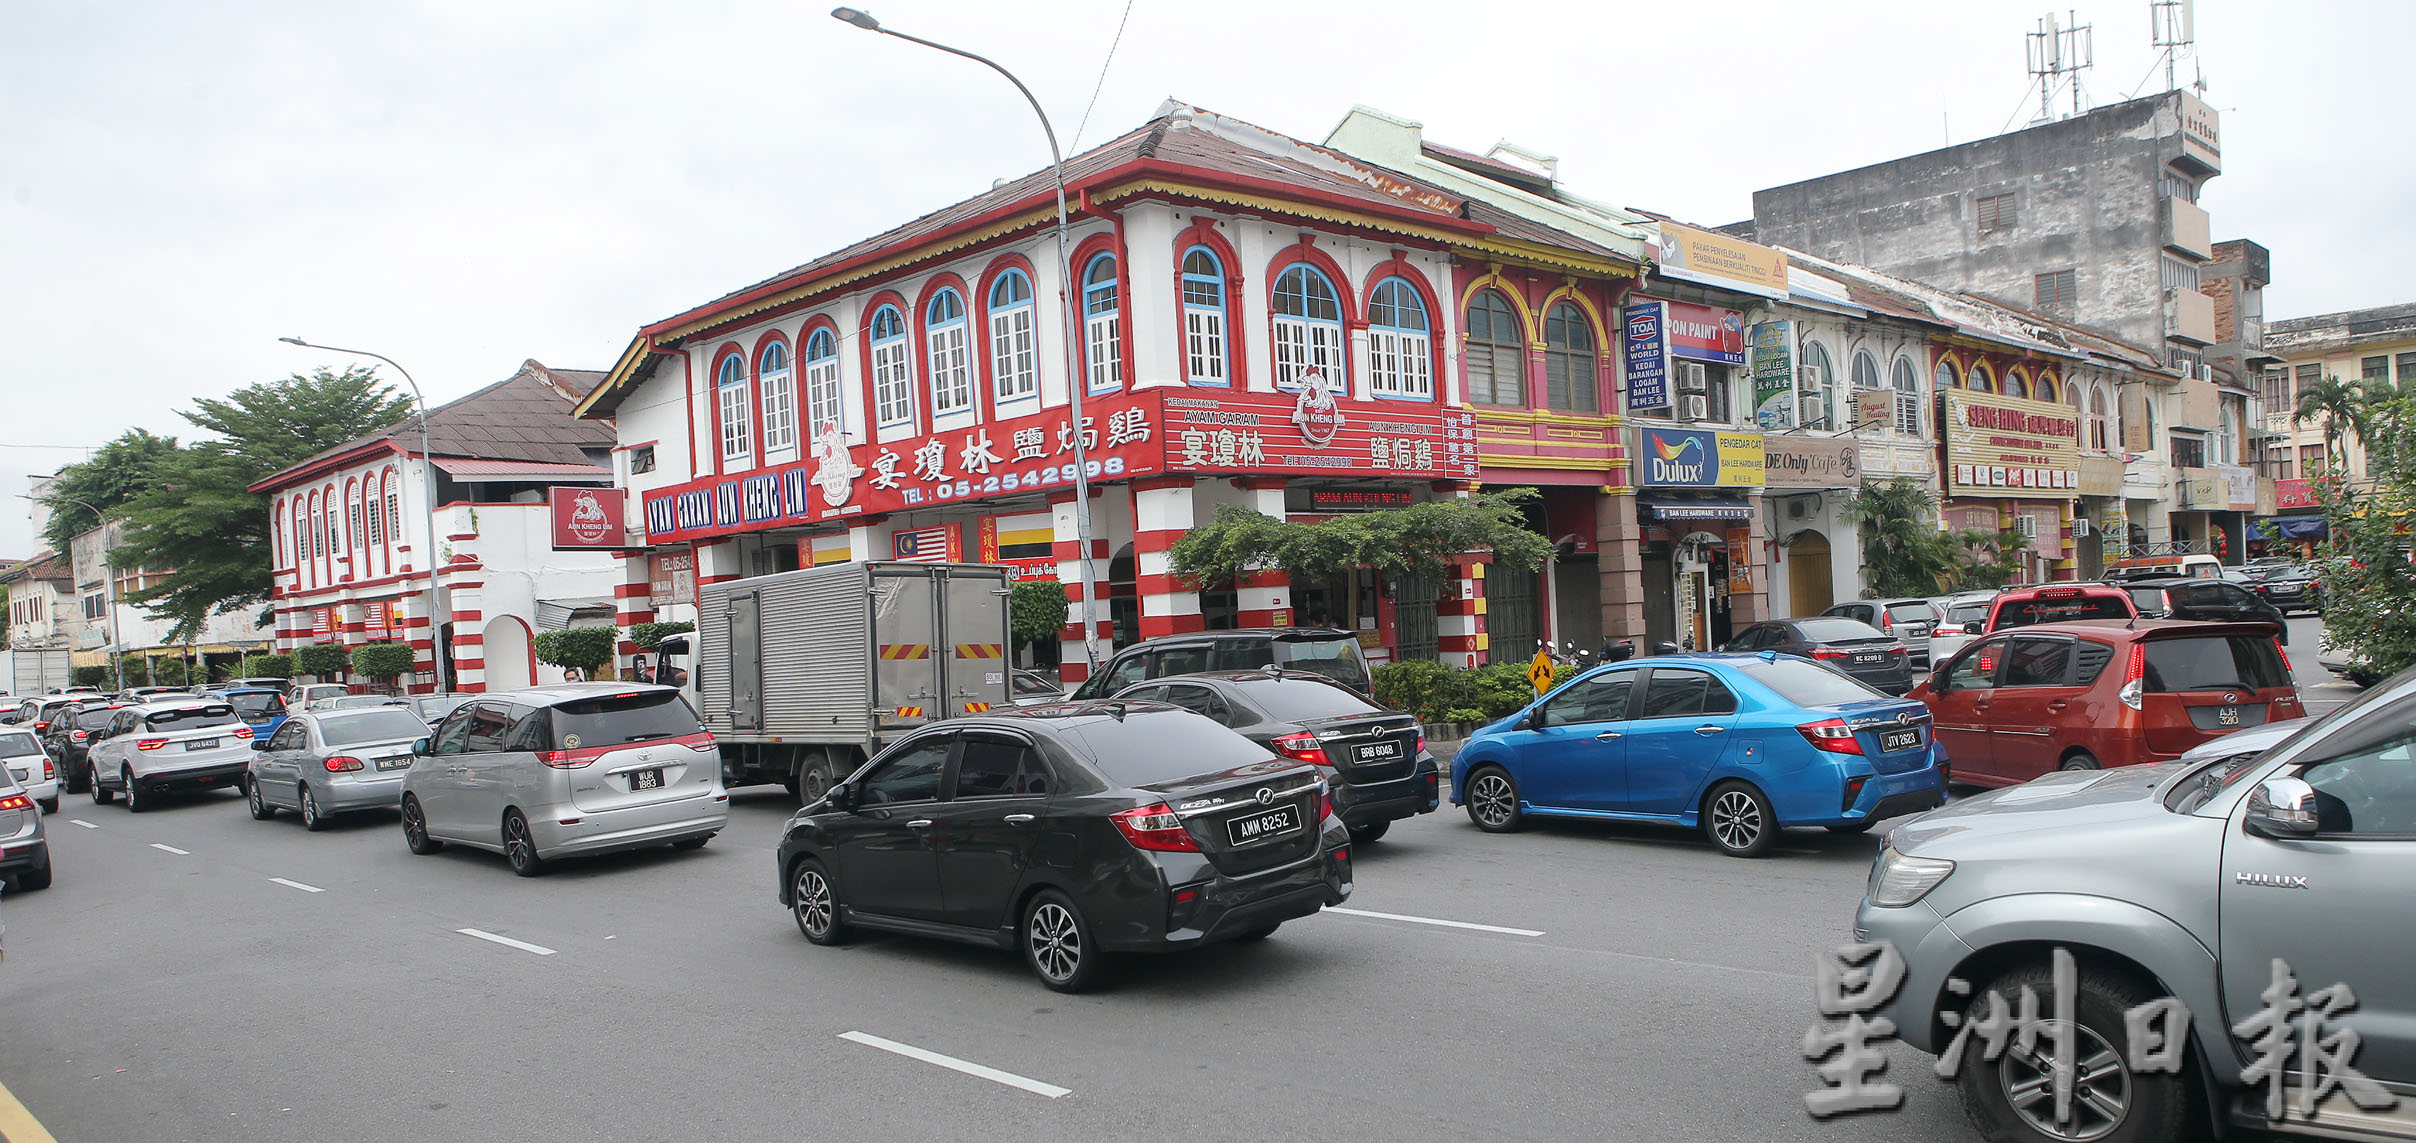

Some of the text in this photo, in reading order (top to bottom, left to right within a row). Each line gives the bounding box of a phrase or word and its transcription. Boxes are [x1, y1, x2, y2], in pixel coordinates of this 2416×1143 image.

[1692, 241, 1710, 252] PAKAR
[1693, 252, 1723, 266] PEMBINAAN
[1631, 322, 1654, 334] TOA
[1689, 322, 1717, 340] PAINT
[1630, 350, 1659, 359] WORLD
[1635, 361, 1655, 370] KEDAI
[1772, 361, 1784, 369] LEE
[1628, 369, 1663, 380] BARANGAN
[1756, 368, 1790, 379] HARDWARE
[1635, 378, 1657, 387] LOGAM
[1633, 386, 1660, 396] BAN LEE
[1168, 397, 1219, 409] KEDAI MAKANAN
[1860, 402, 1886, 412] August
[1184, 411, 1260, 426] AYAM GARAM
[1311, 414, 1332, 423] KHENG
[1866, 410, 1890, 419] Healing
[1968, 405, 2026, 432] SENG HING
[1368, 422, 1433, 434] AUN KHENG LIM
[1181, 425, 1266, 468] 宴瓊林
[1720, 438, 1761, 449] PENGEDAR CAT
[1300, 456, 1352, 467] 05-2542998
[1739, 460, 1762, 468] HARDWARE
[1783, 452, 1809, 474] Only
[1653, 458, 1699, 482] Dulux
[936, 457, 1125, 498] 05-2542998
[647, 467, 808, 535] AYAM GARAM AUN KHENG LIM
[1668, 509, 1679, 517] BAN
[2220, 708, 2237, 716] AJH
[2220, 716, 2238, 724] 3210
[1888, 733, 1915, 747] JTV 2623
[1360, 744, 1394, 758] BRB 6048
[395, 756, 411, 767] 1654
[638, 771, 654, 779] WUR
[638, 779, 656, 789] 1883
[1241, 812, 1289, 837] AMM 8252
[2236, 872, 2308, 889] HILUX
